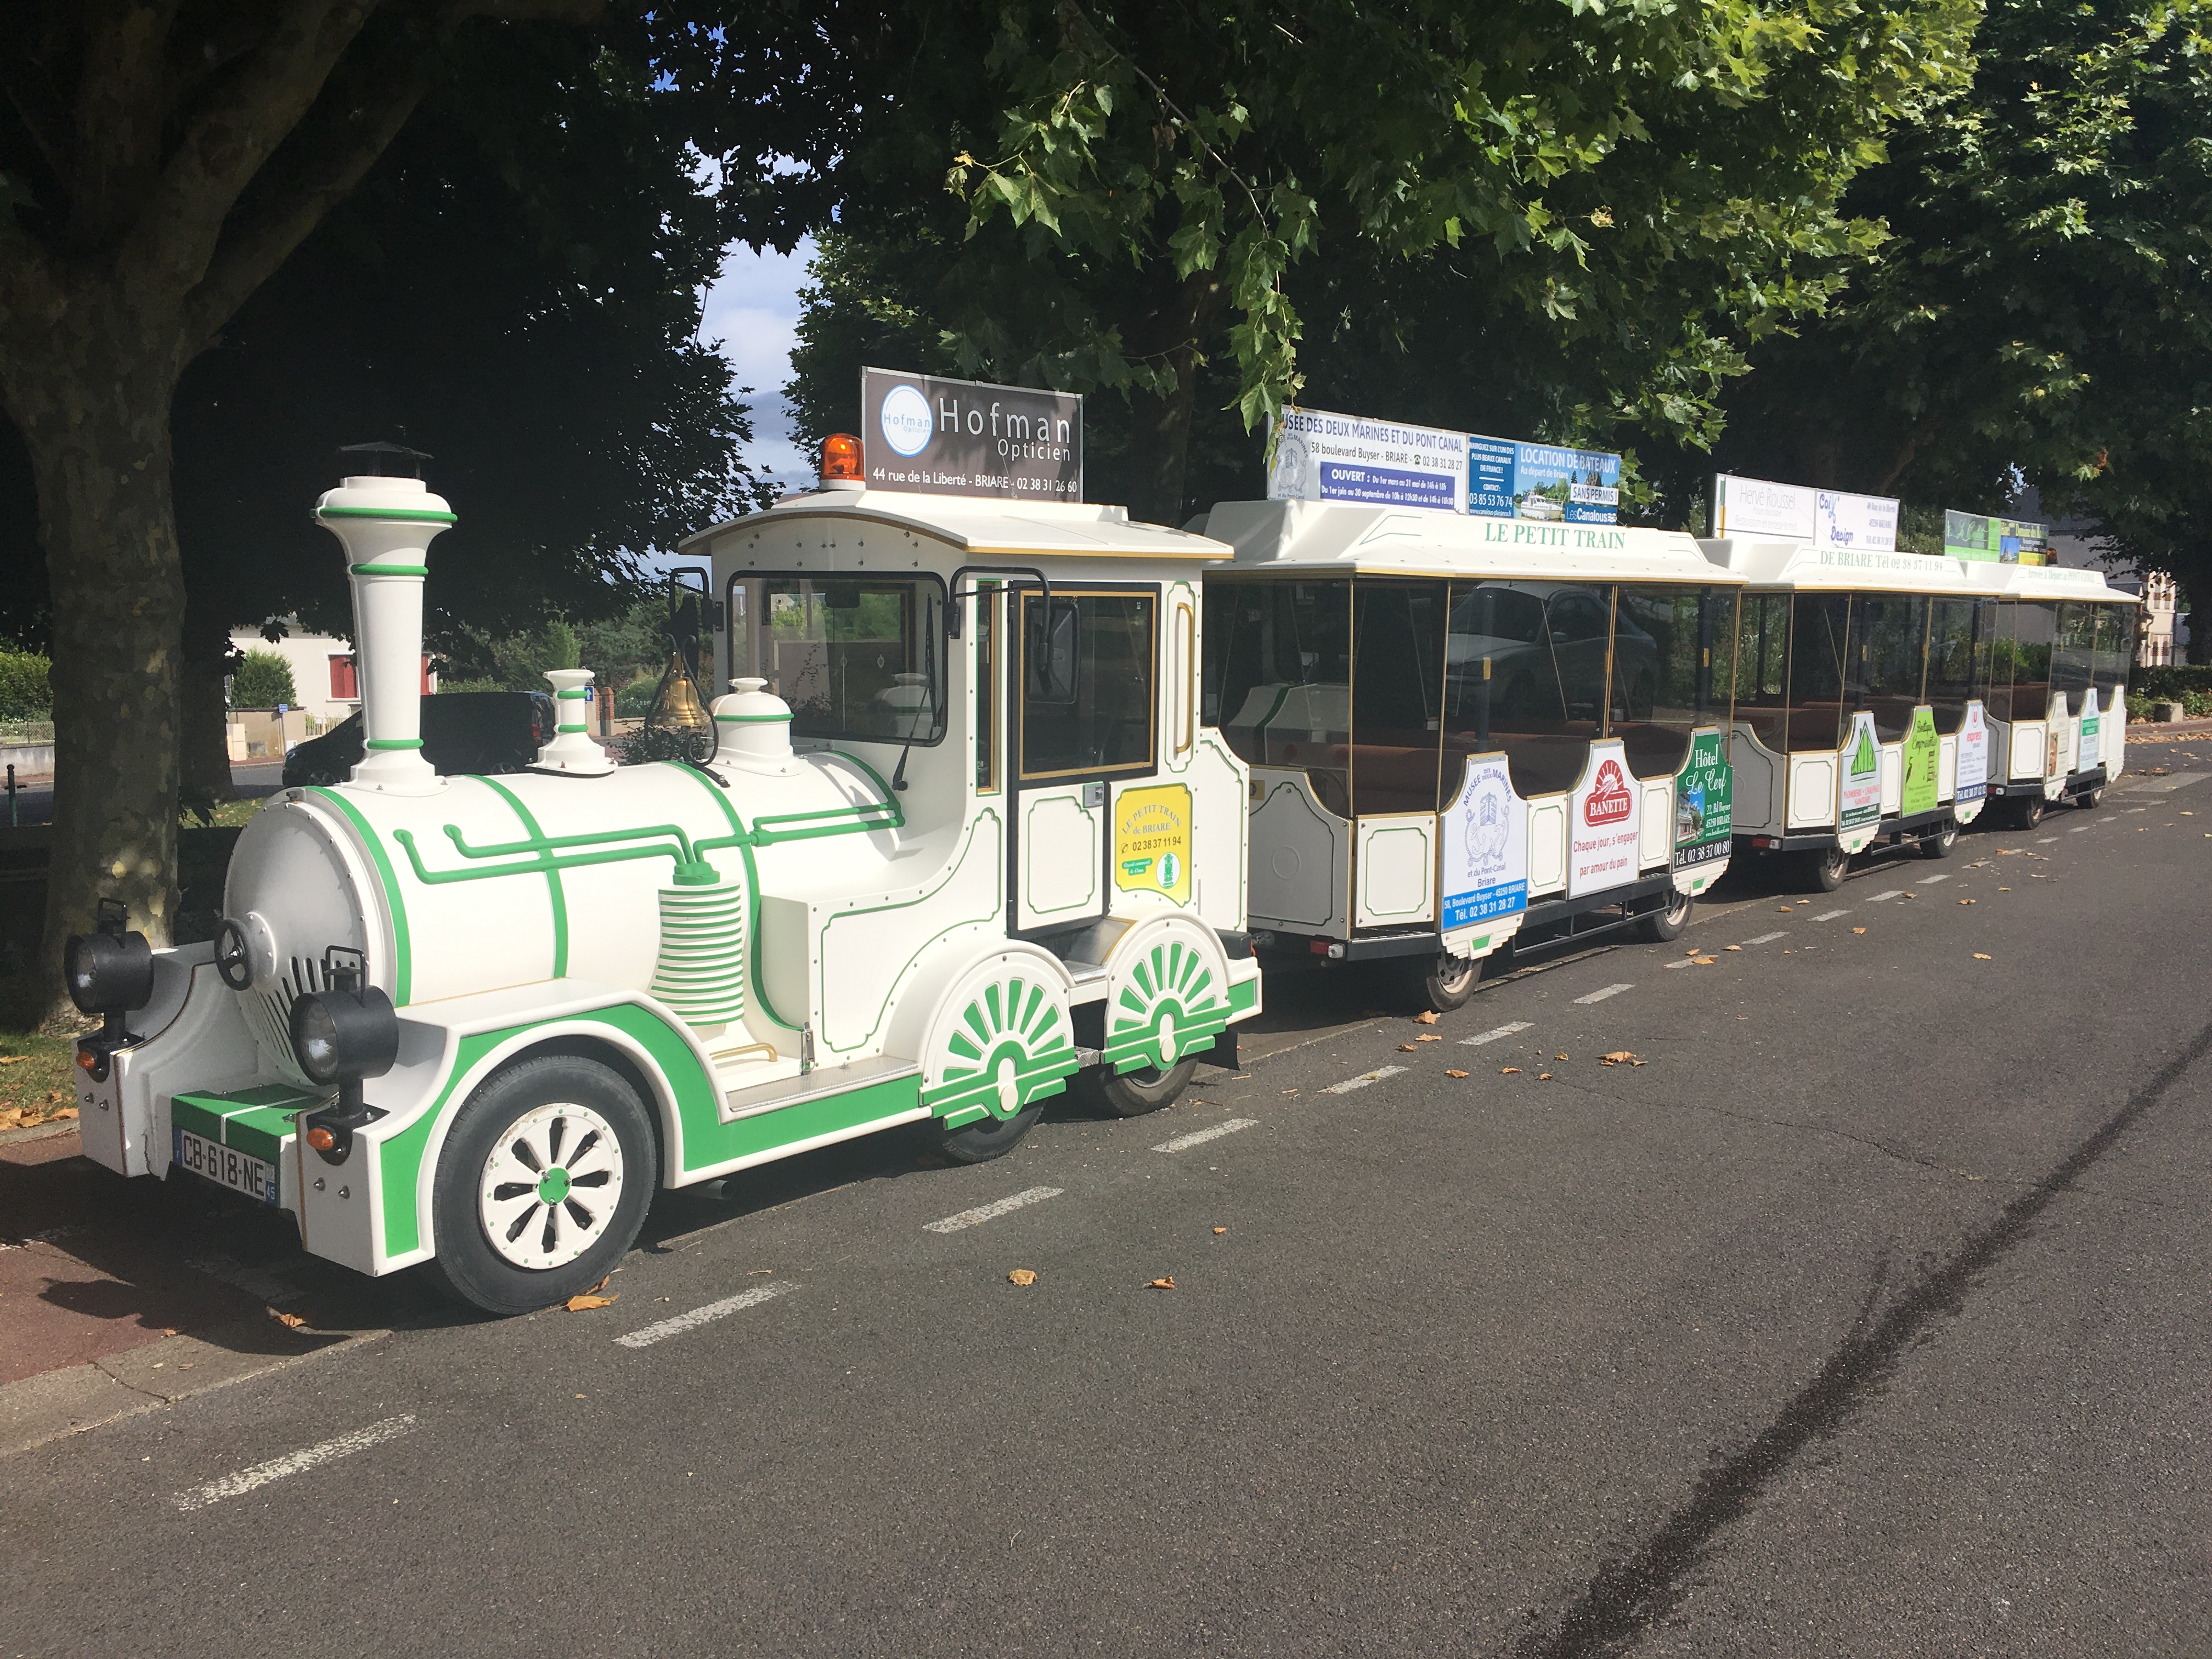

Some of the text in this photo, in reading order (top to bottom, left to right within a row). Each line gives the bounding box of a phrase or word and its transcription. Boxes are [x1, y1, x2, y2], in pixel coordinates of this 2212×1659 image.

[884, 413, 930, 427] Hofman
[939, 397, 1070, 443] Hofman
[1307, 417, 1463, 453] DES DEUX MARINES ET DU PONT CANAL
[997, 438, 1070, 461] Opticien
[1312, 442, 1463, 471] 58 boulevard Buyser BRIARE 02 38 31 28 27
[1471, 453, 1511, 464] PLUS BEAUX CANAUX
[1489, 444, 1497, 453] SUR
[1520, 447, 1616, 474] LOCATION DE BATEAUX
[1520, 465, 1568, 479] Au départ de Briare
[873, 467, 1077, 493] 44 rue de la Liberté BRIARE 02 38 31 26 60
[1331, 469, 1365, 482] OUVERT
[1372, 475, 1379, 484] Du
[1405, 479, 1411, 487] 31
[1412, 479, 1420, 488] mai
[1420, 480, 1426, 489] de
[1321, 485, 1328, 494] Du
[1329, 486, 1338, 494] 1er
[1338, 486, 1347, 497] juin
[1355, 488, 1361, 496] 30
[1362, 490, 1384, 500] septembre
[1385, 490, 1391, 499] de
[1392, 492, 1400, 500] 10h
[1423, 494, 1429, 503] de
[1469, 493, 1513, 507] 03 85 53 76 74
[1573, 487, 1613, 502] SANS PERMIS
[1740, 484, 1796, 510] Hervé Roussel
[1485, 522, 1626, 549] LE PETIT TRAIN
[1830, 525, 1854, 546] Design
[1820, 550, 1943, 571] DE BRIARE Tél 02 38 37 11 94
[1694, 743, 1718, 769] Hôtel
[1463, 769, 1512, 806] MUSEE MARINES
[1685, 767, 1726, 797] Le Cerf
[1589, 797, 1628, 817] BANETTE
[1122, 804, 1182, 834] LE PETIT TRAIN
[1133, 822, 1171, 834] de BRIARE
[1132, 836, 1181, 851] 02 38 37 11 94
[1573, 840, 1596, 853] Chaque
[1597, 837, 1611, 851] jour,
[1675, 840, 1730, 866] Tél. 02 38 37 00 80
[1474, 868, 1480, 877] du
[1481, 862, 1506, 875] Pont-Canal
[1579, 855, 1628, 879] par amour du pain
[1477, 877, 1496, 888] Briare
[1452, 894, 1476, 907] Boulevard
[1476, 892, 1493, 903] Buyser
[1496, 887, 1508, 897] 45250
[1508, 882, 1525, 894] BRIARE
[1455, 896, 1515, 921] Tél. 02 38 31 28 27
[183, 1135, 275, 1200] CB-618-NE 45
